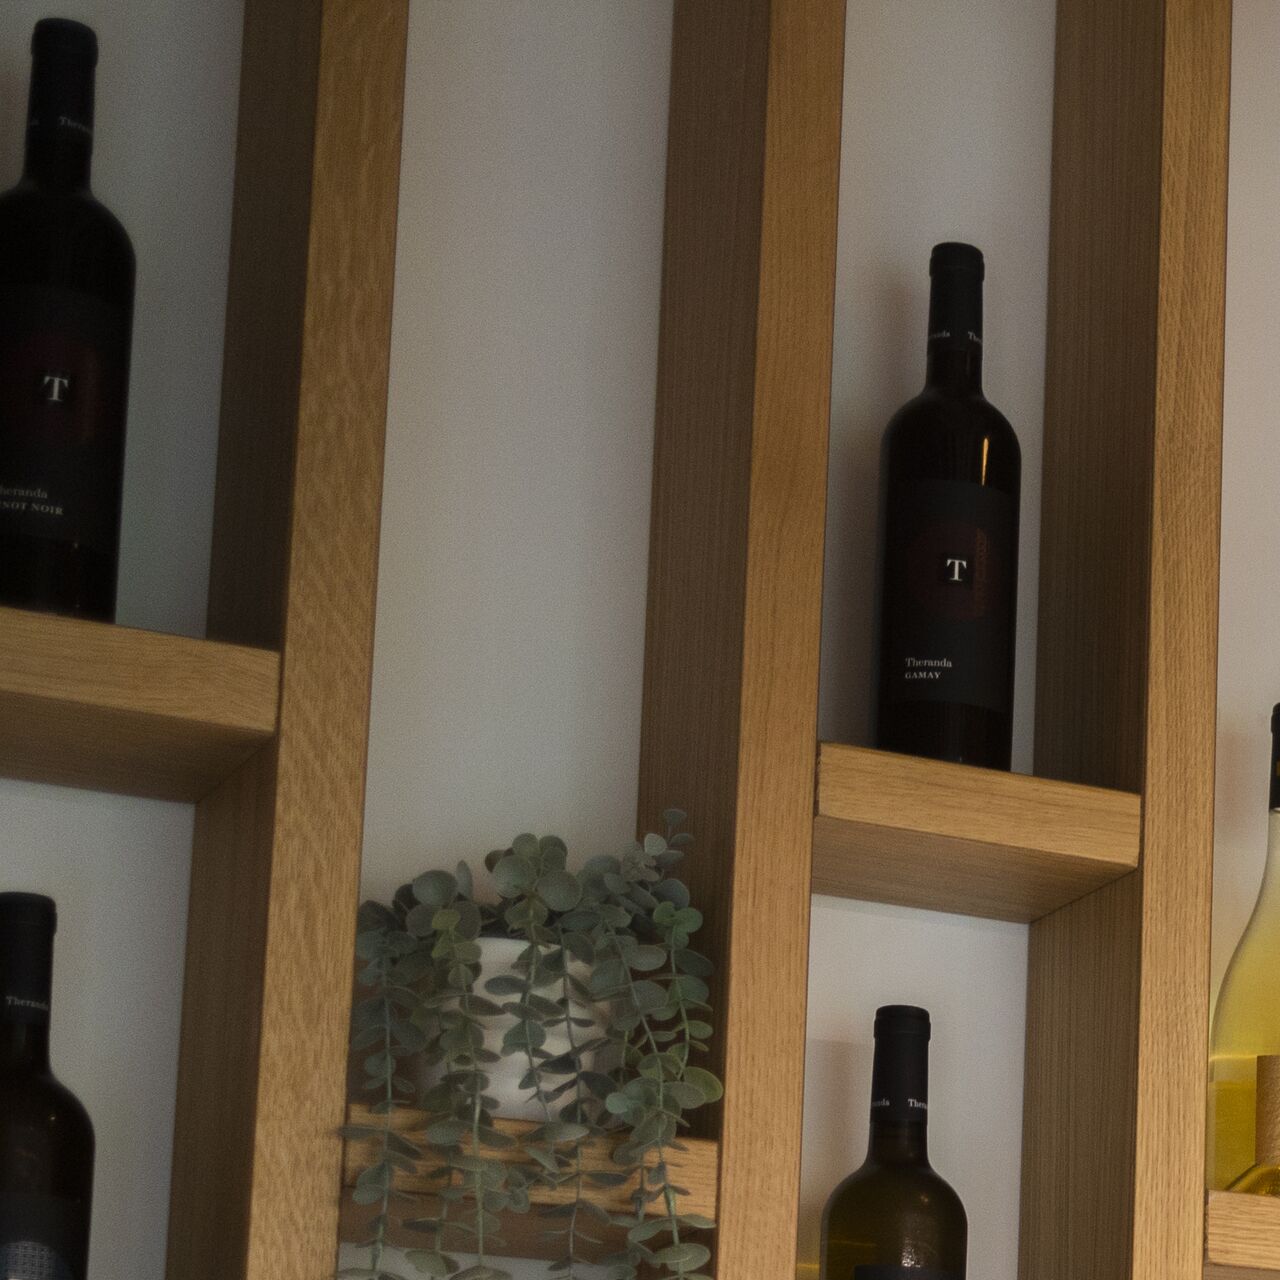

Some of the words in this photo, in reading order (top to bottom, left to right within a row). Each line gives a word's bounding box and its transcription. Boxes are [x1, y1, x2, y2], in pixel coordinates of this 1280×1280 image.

[44, 375, 70, 403] T
[0, 486, 48, 499] heranda
[946, 558, 967, 581] T
[905, 657, 952, 669] Theranda
